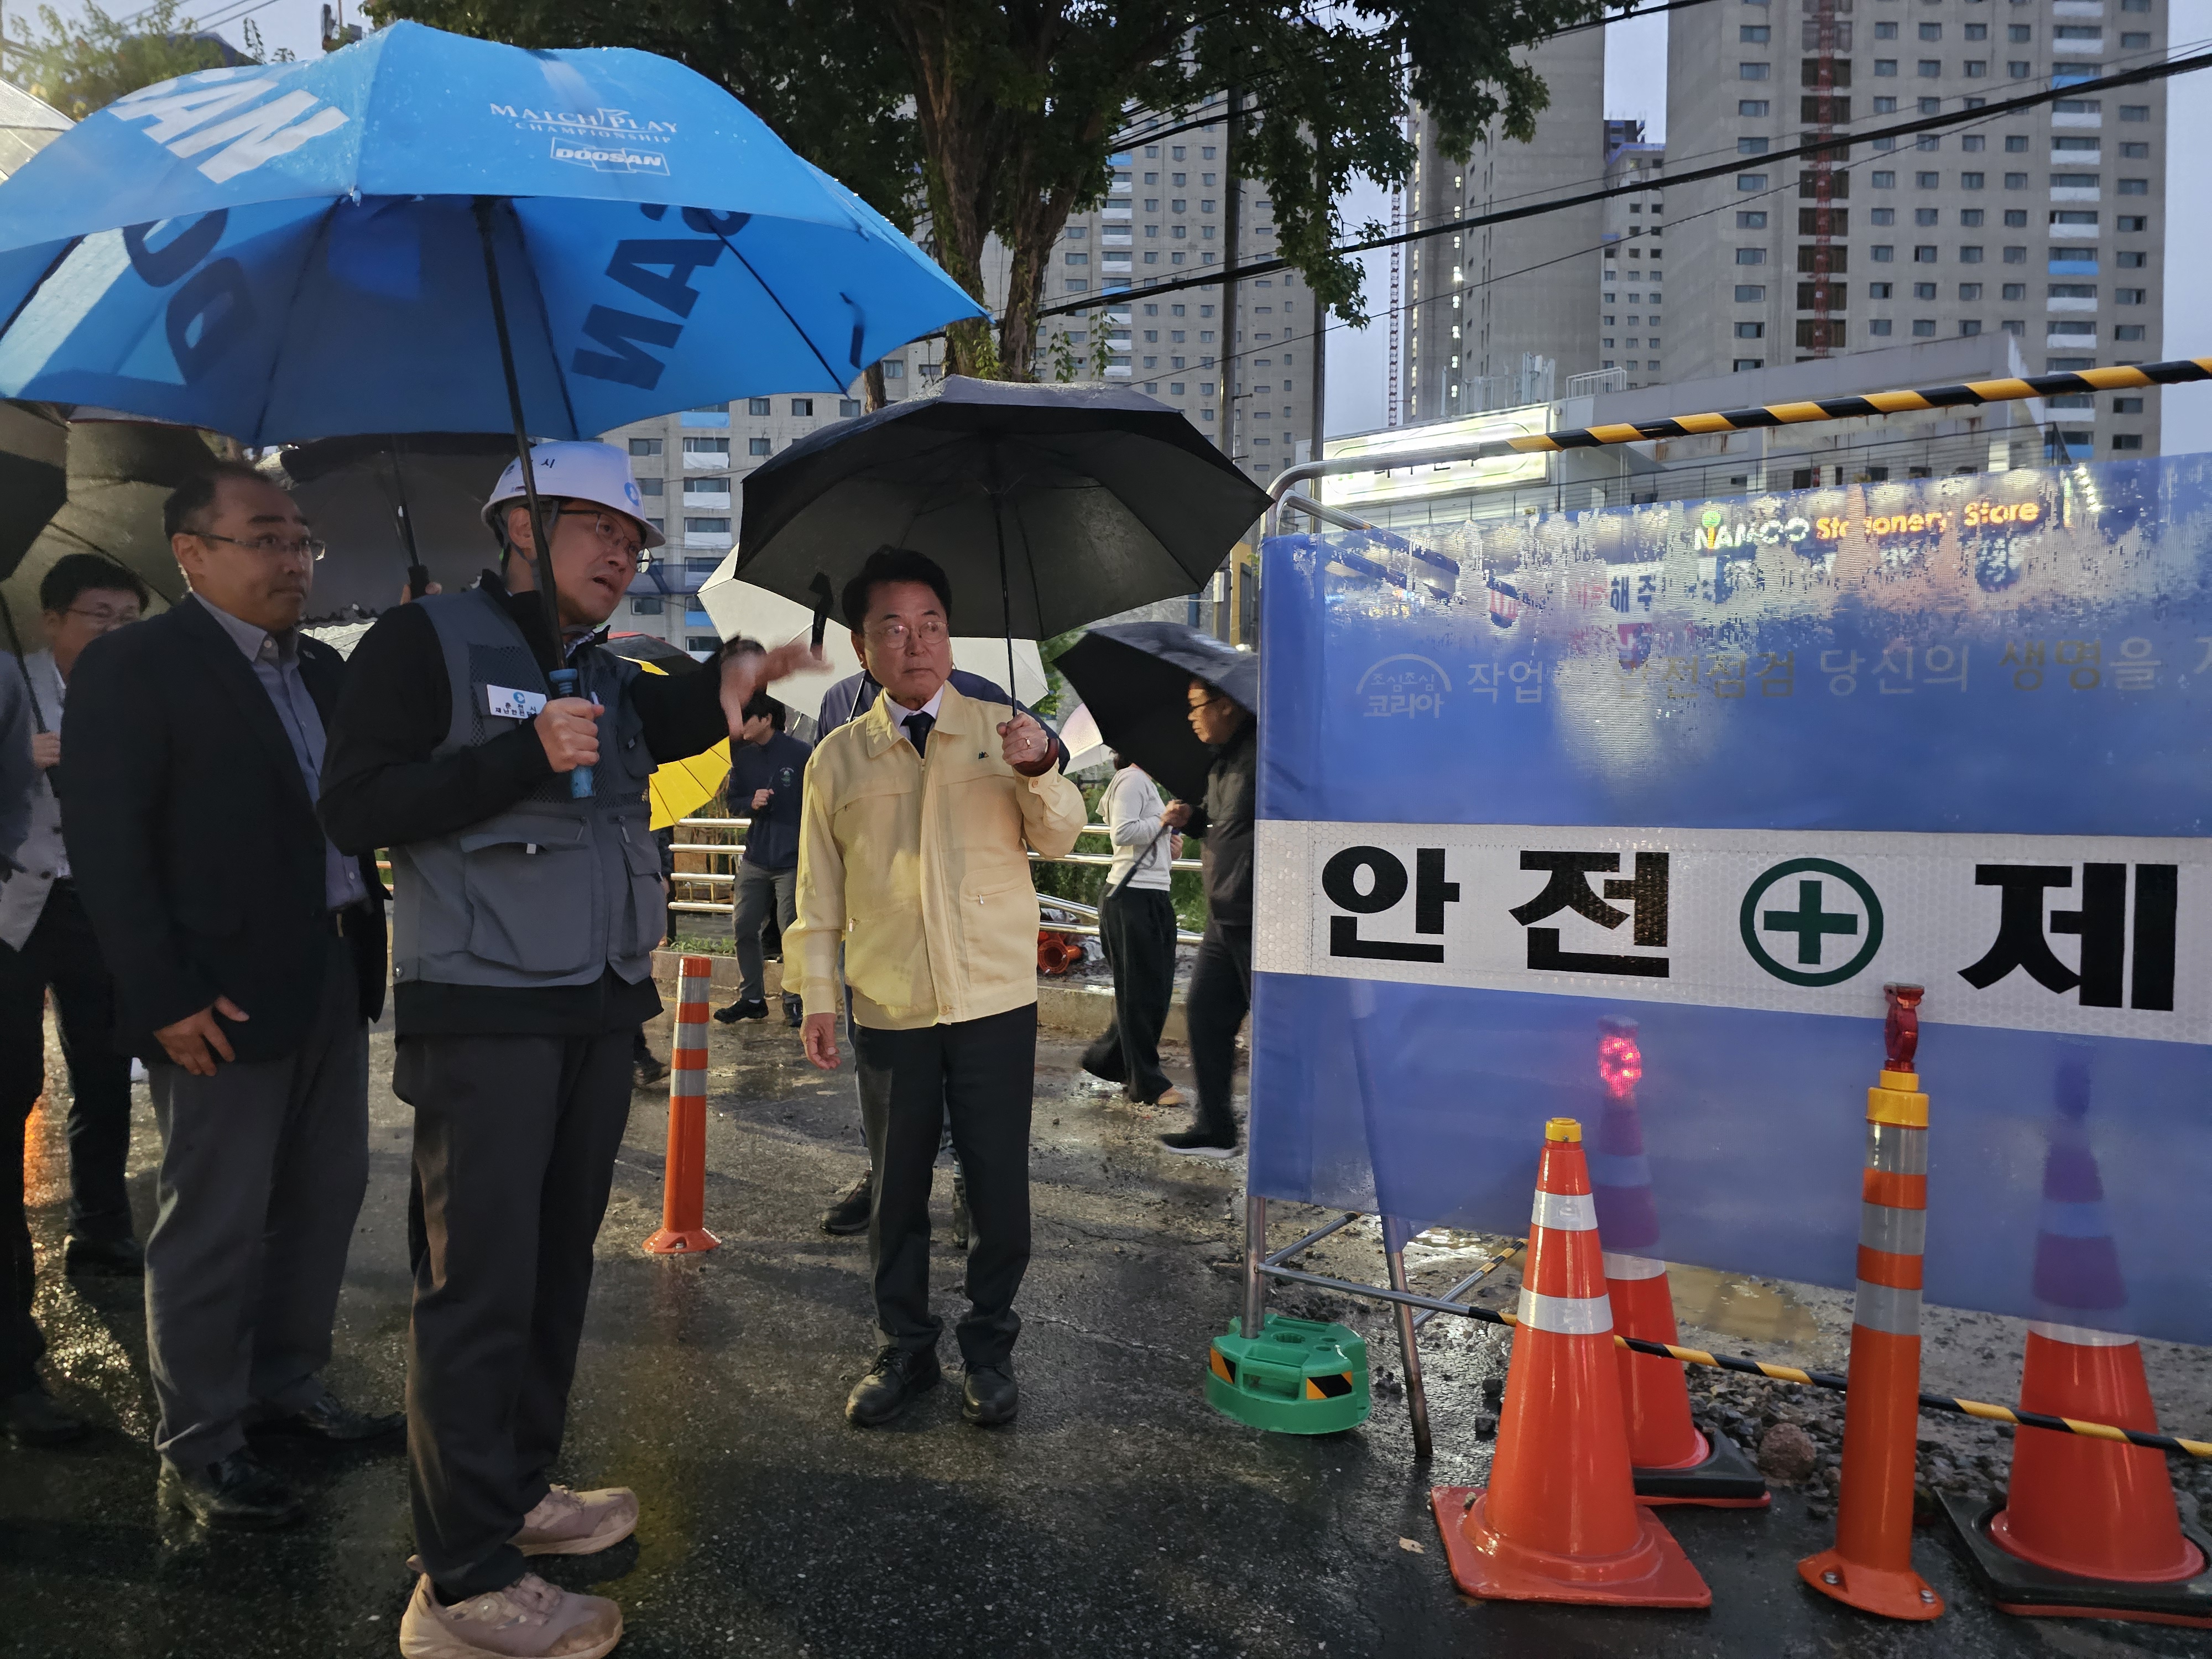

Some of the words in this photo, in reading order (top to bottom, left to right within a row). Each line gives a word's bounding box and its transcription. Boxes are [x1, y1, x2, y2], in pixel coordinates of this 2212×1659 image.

[490, 103, 598, 126] MATCH
[609, 116, 677, 133] PLAY
[515, 122, 671, 143] CHAMPIONSHIP
[556, 148, 661, 166] DOOSAN
[1820, 645, 1969, 696] 당신의
[1998, 636, 2161, 691] 생명을
[1363, 692, 1444, 719] 코리아
[1322, 845, 1670, 979] 안전
